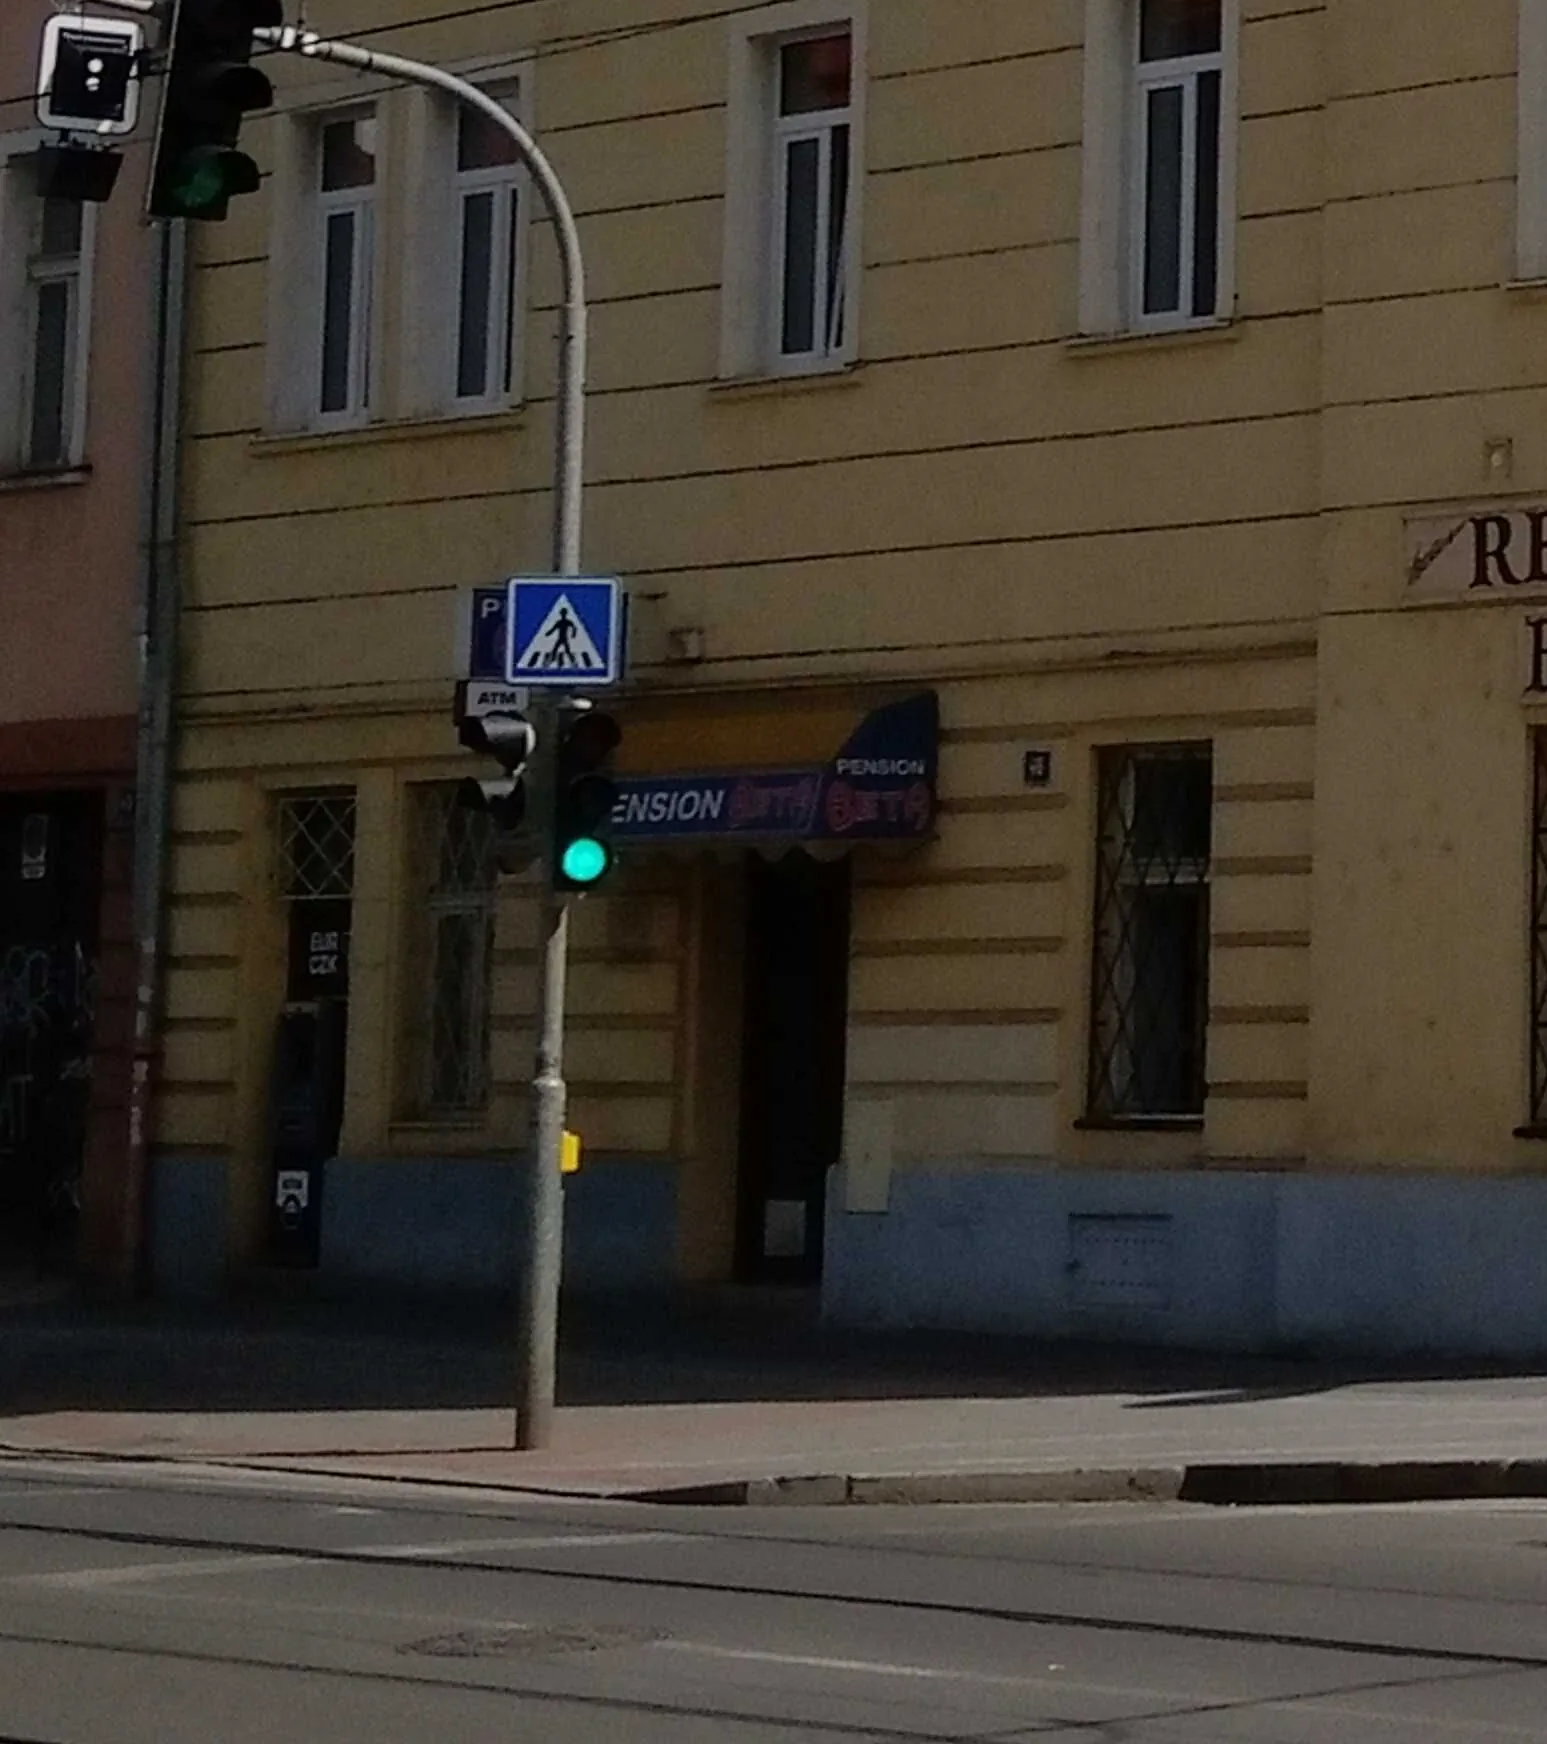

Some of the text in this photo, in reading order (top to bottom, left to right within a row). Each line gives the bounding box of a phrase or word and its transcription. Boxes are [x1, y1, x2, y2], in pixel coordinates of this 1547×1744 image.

[477, 691, 517, 705] ATM
[836, 758, 925, 775] PENSION
[611, 789, 725, 823] ENSION
